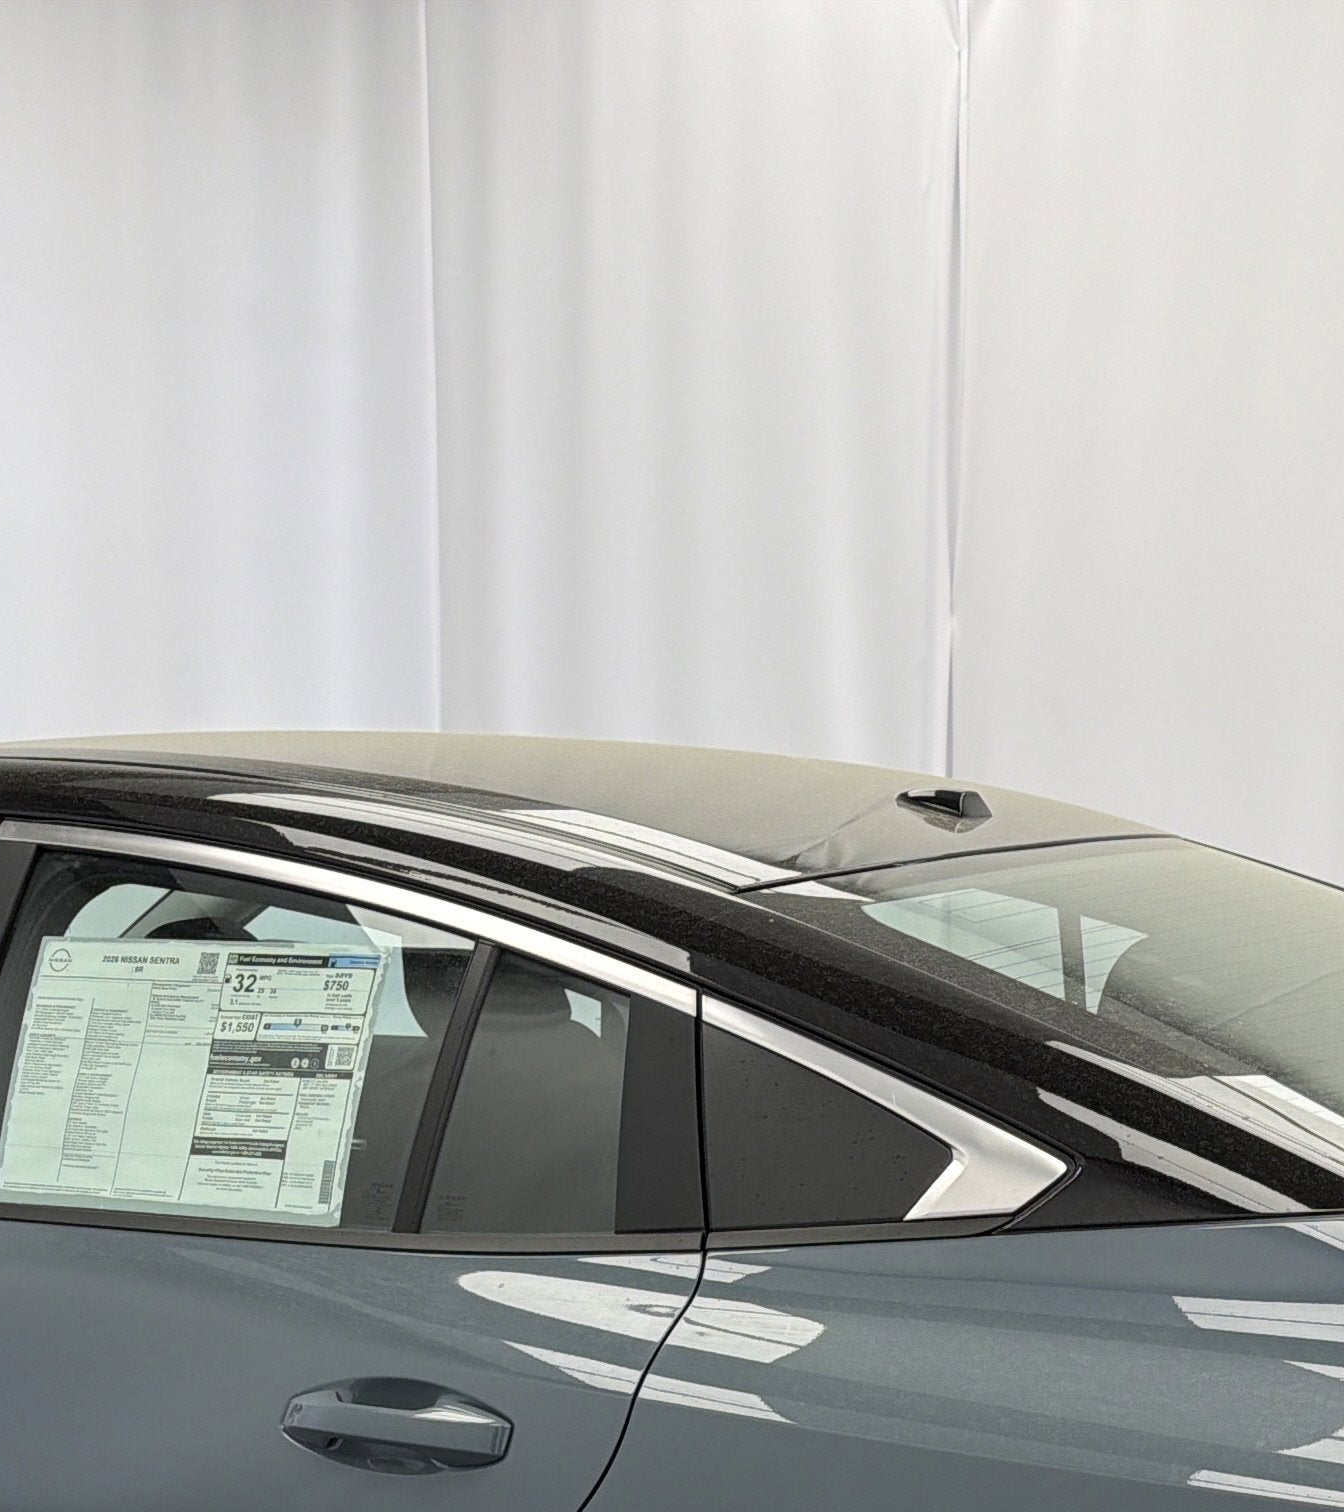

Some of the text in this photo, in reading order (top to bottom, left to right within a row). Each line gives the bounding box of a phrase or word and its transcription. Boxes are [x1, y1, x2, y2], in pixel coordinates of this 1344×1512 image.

[120, 956, 148, 964] NISSAN
[149, 957, 180, 965] SENTRA
[232, 973, 257, 993] 32
[323, 980, 350, 992] $750
[220, 1021, 255, 1034] $1,550
